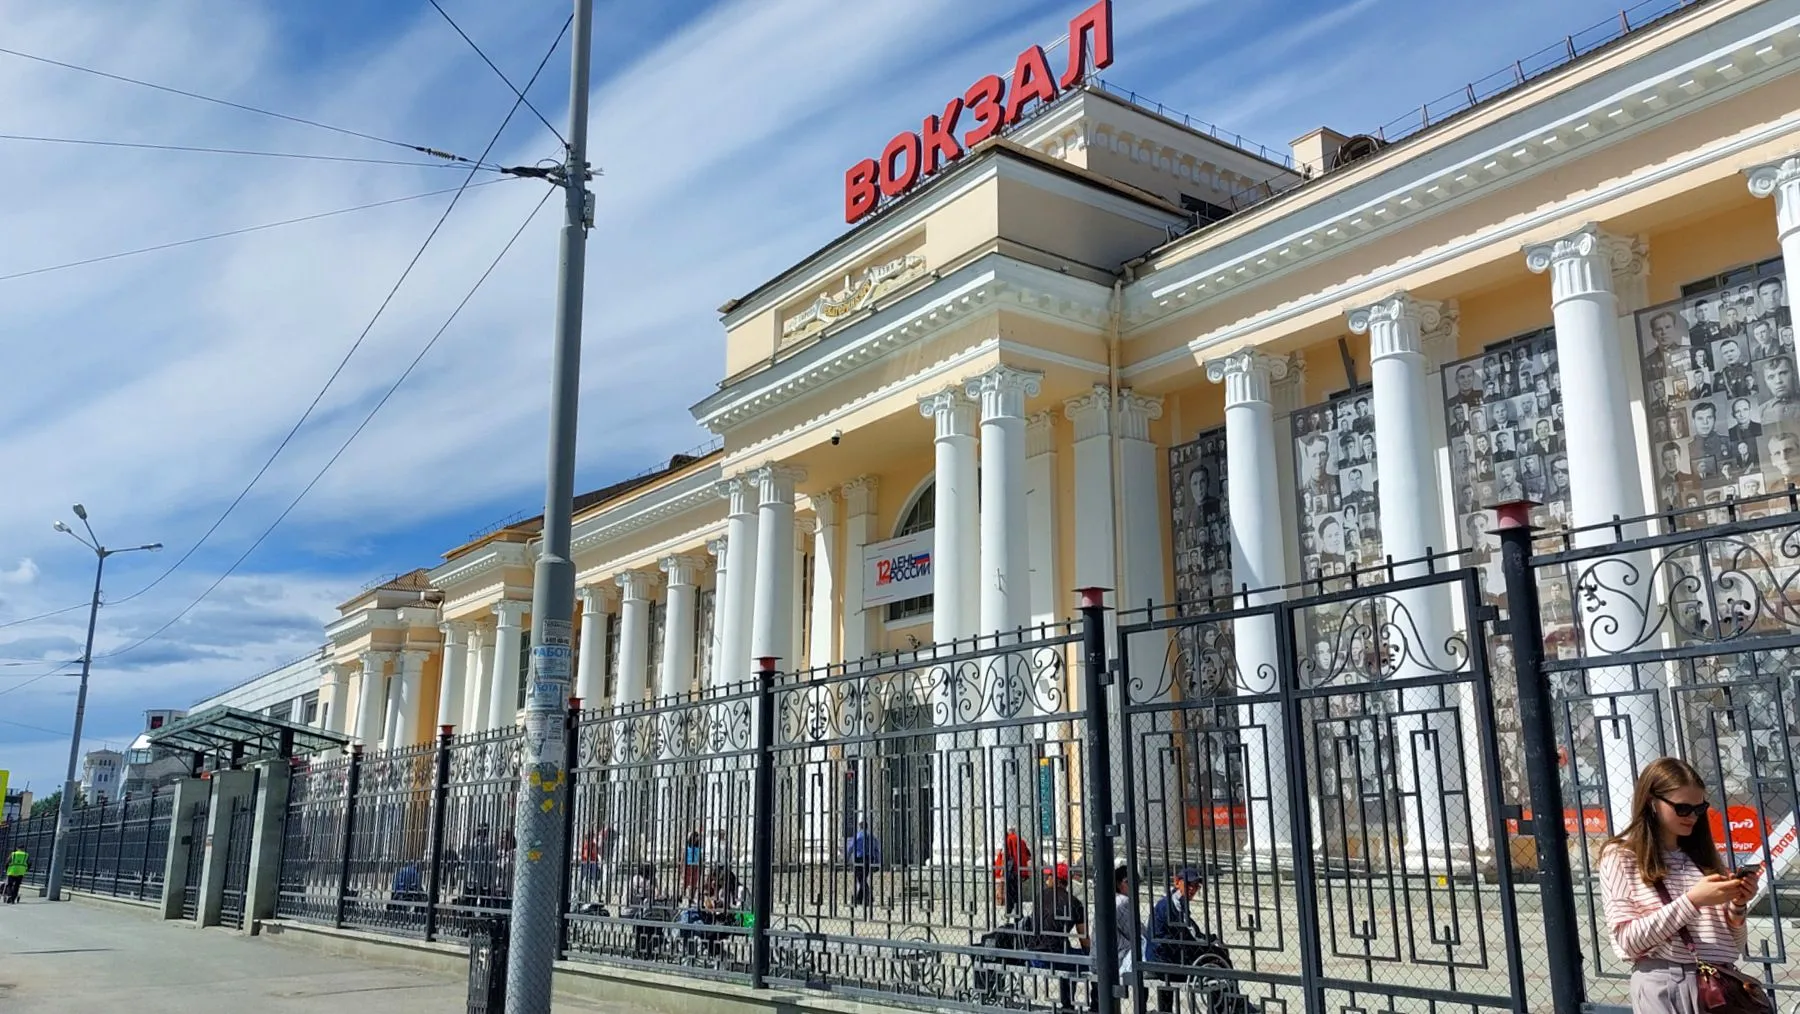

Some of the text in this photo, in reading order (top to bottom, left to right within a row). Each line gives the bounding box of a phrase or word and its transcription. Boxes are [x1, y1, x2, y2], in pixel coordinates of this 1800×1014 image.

[846, 0, 1114, 224] ВОКЗАЛ
[877, 554, 916, 581] 12 ДЕНЬ
[889, 563, 931, 583] РОССИИ
